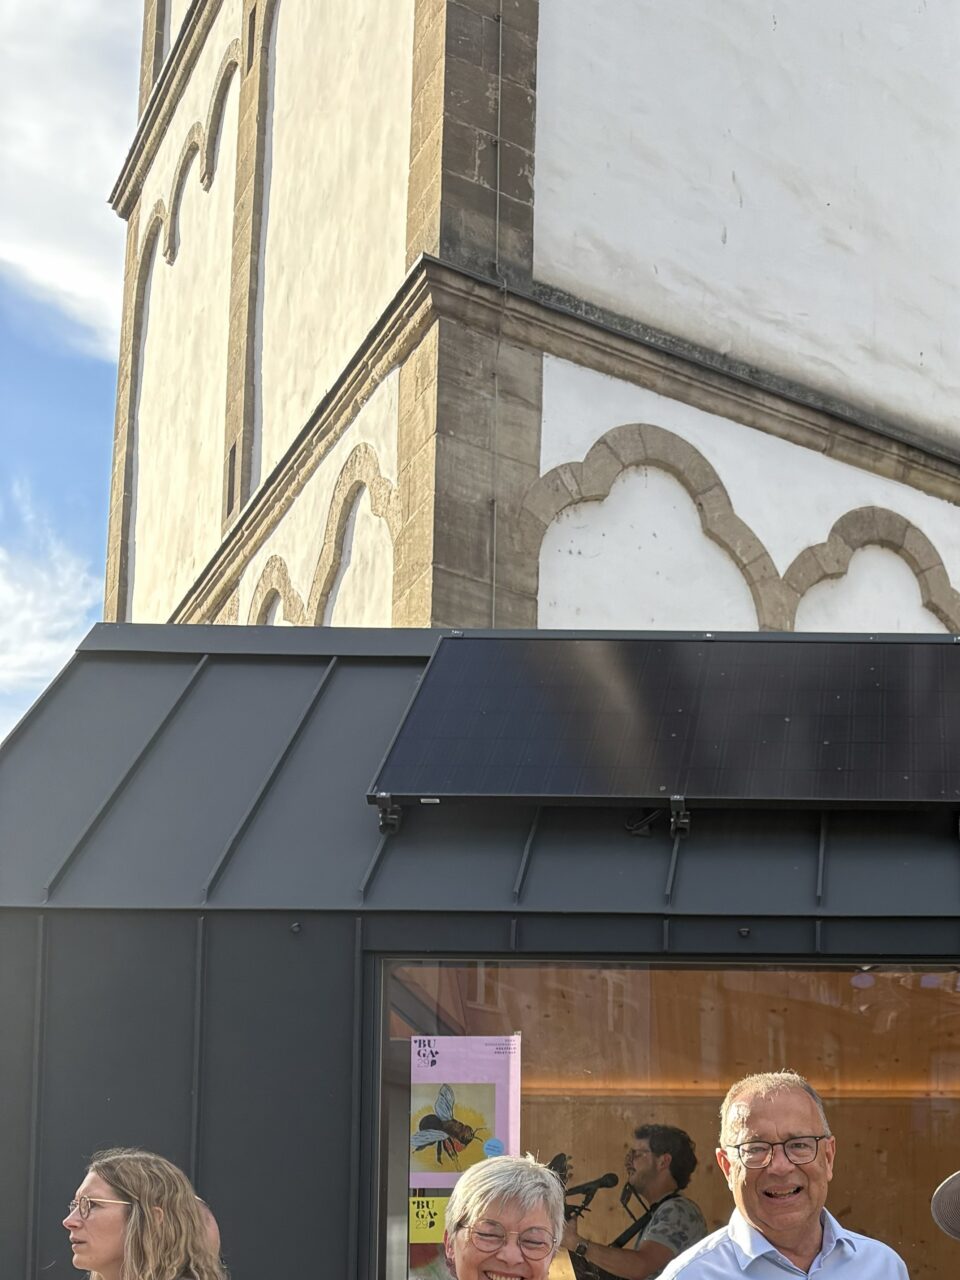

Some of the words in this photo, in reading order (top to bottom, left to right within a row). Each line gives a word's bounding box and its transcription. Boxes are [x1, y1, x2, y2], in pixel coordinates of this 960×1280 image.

[418, 1039, 436, 1049] BU
[417, 1049, 435, 1058] GA
[417, 1059, 430, 1068] 29
[416, 1200, 435, 1210] BU
[415, 1210, 434, 1219] GA
